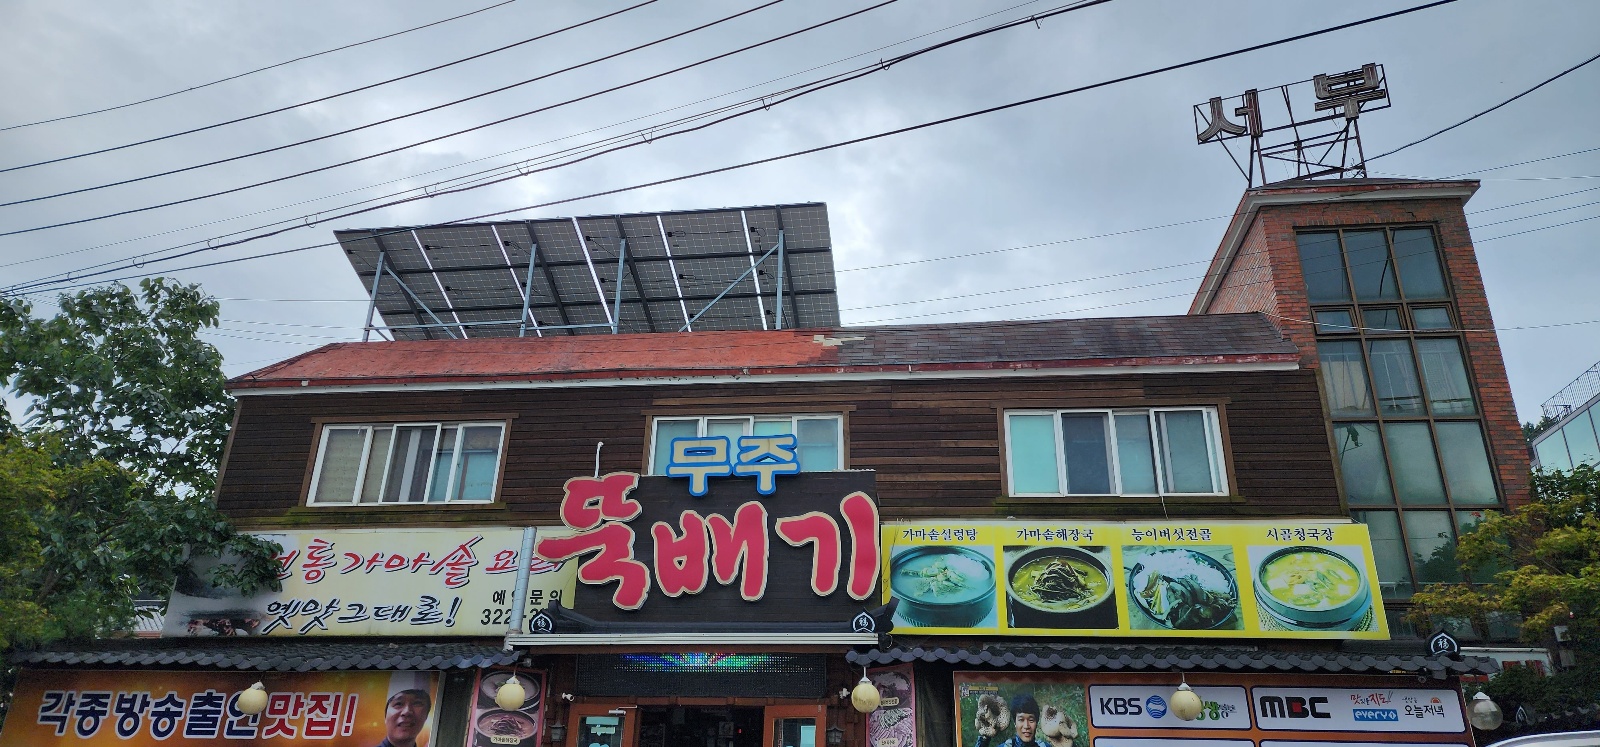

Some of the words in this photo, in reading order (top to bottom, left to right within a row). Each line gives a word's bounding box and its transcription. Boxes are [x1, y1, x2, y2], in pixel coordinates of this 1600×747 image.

[666, 434, 801, 497] 무주
[534, 472, 880, 611] 뚝배기
[1016, 528, 1095, 542] 가마솥해장국
[1131, 527, 1213, 542] 능이버섯전골
[1266, 527, 1335, 542] 시골청국장
[1100, 697, 1142, 716] KBS
[1260, 696, 1331, 718] MBC
[1404, 705, 1445, 718] 오늘저녁
